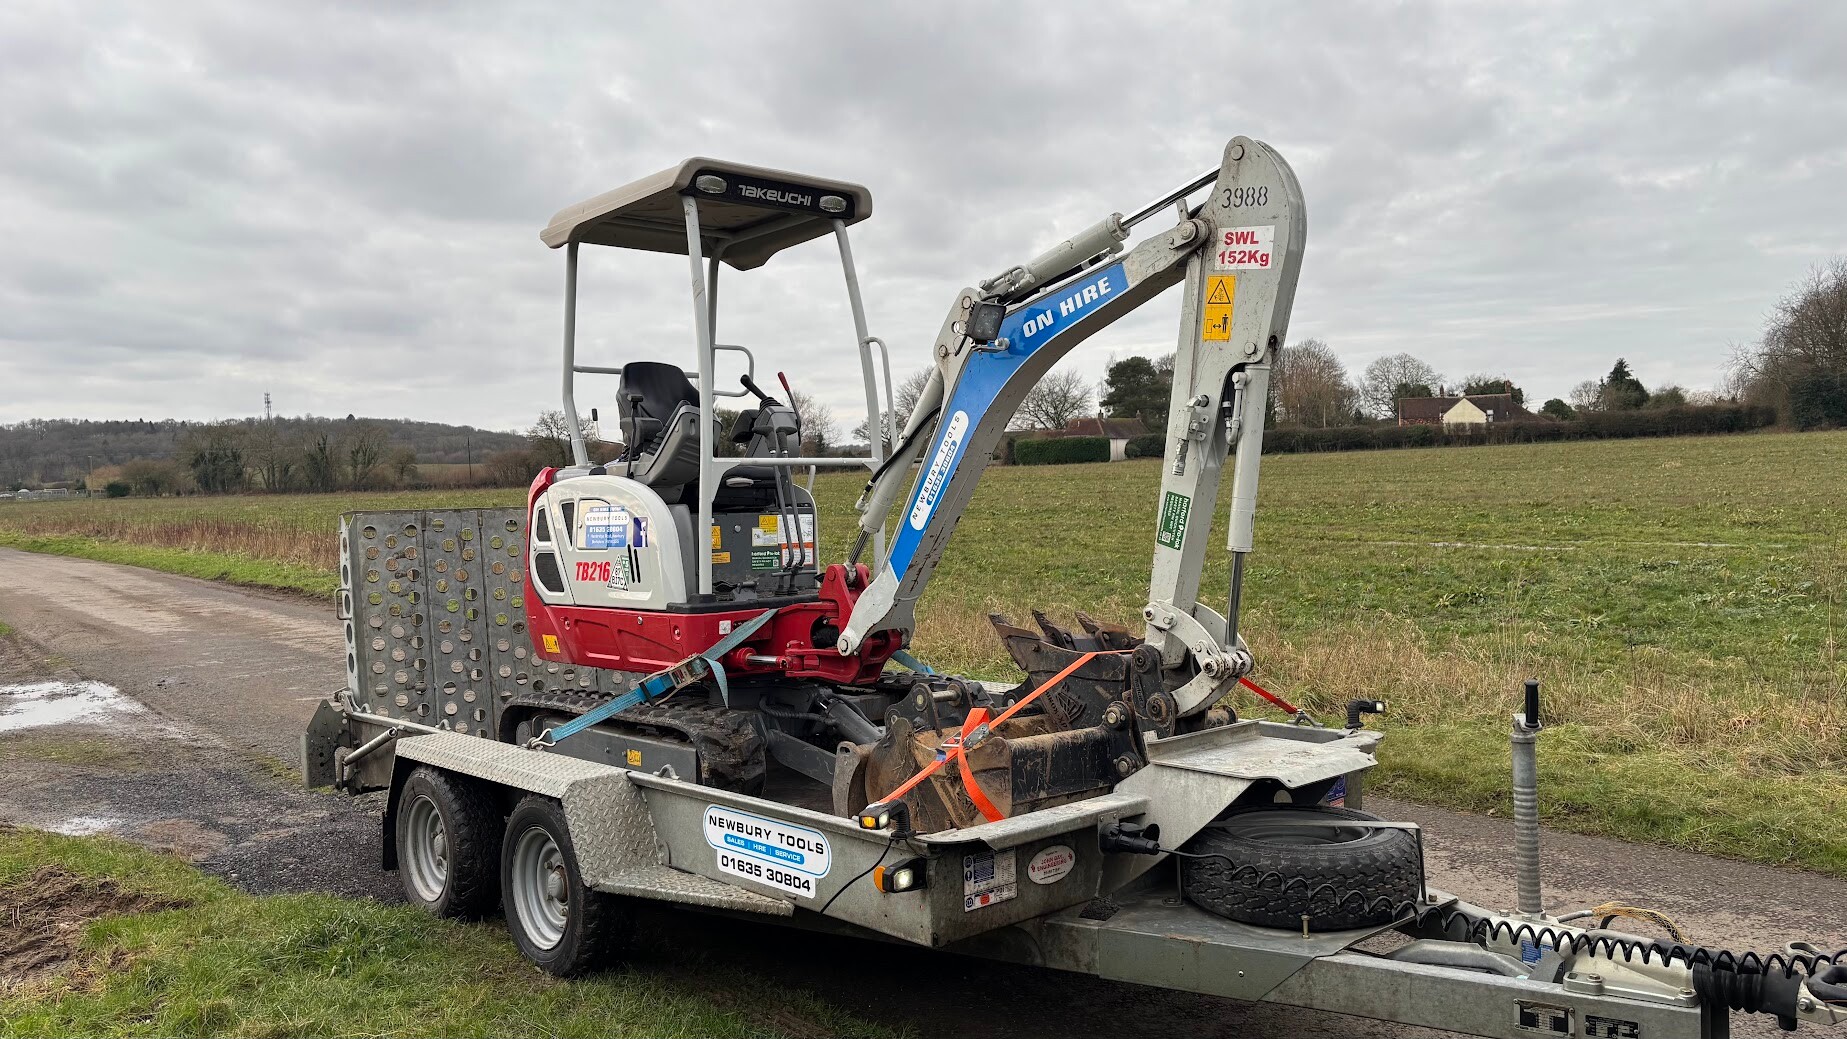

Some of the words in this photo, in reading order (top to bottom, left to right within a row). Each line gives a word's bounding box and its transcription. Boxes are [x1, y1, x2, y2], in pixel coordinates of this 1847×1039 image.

[1221, 186, 1268, 208] 3988
[1224, 231, 1259, 246] SWL
[1218, 250, 1270, 267] 152Kg
[1022, 309, 1054, 338] ON
[1059, 276, 1112, 317] HIRE
[912, 461, 940, 520] NEWBURY
[941, 415, 960, 454] TOOLS
[575, 561, 611, 582] TB216
[709, 815, 772, 840] NEWBURY
[778, 832, 825, 855] TOOLS
[726, 837, 745, 847] SALES
[753, 844, 767, 853] HIRE
[775, 850, 801, 862] SERVICE
[721, 855, 762, 878] 01635
[767, 868, 811, 892] 30804
